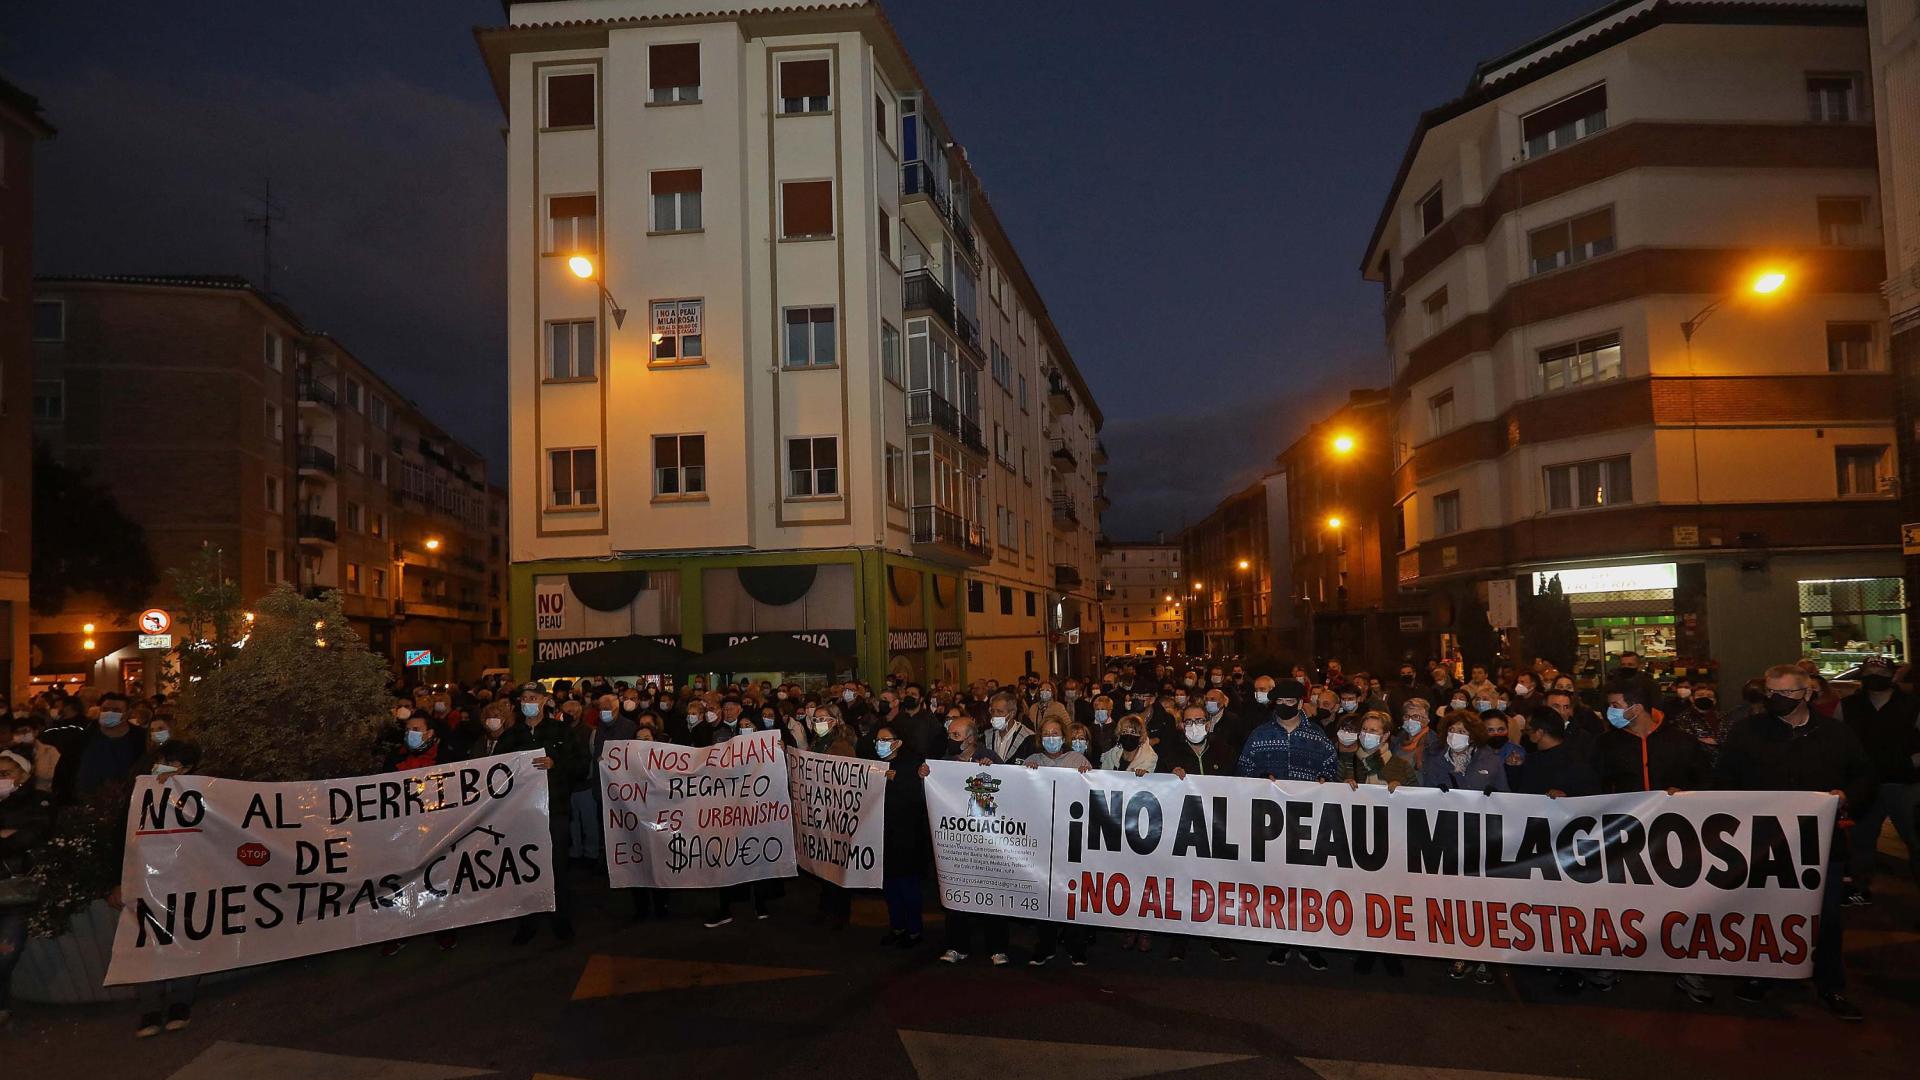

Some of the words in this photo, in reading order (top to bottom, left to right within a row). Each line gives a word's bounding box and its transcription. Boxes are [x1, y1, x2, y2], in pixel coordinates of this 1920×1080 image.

[680, 308, 696, 316] PEAU
[538, 593, 563, 614] NO
[539, 615, 562, 629] PEAU
[888, 631, 928, 650] PANADERIA
[935, 631, 962, 647] CAFETERIA
[647, 748, 691, 772] NOS
[705, 735, 775, 768] ECHAN
[789, 754, 871, 790] PRETENDEN
[138, 787, 205, 830] NO
[241, 792, 302, 829] AL
[328, 762, 514, 825] DERRIBO
[607, 781, 648, 803] CON
[668, 774, 771, 800] REGATEO
[609, 808, 638, 831] NO
[656, 809, 684, 832] ES
[1068, 789, 1163, 863] ¡NO
[1171, 794, 1239, 862] AL
[1251, 798, 1390, 872] PEAU
[1406, 807, 1822, 890] MILAGROSA!
[239, 849, 267, 859] STOP
[295, 837, 349, 876] DE
[614, 842, 643, 865] ES
[135, 873, 403, 948] NUESTRAS
[423, 843, 541, 897] CASAS
[945, 888, 971, 904] 665
[975, 892, 994, 906] 08
[999, 894, 1014, 909] 11
[1020, 896, 1039, 911] 48
[1066, 870, 1130, 921] ¡NO
[1137, 875, 1182, 921] AL
[1191, 878, 1354, 936] DERRIBO
[1366, 893, 1416, 943] DE
[1426, 896, 1648, 959] NUESTRAS
[1660, 910, 1820, 965] CASAS!
